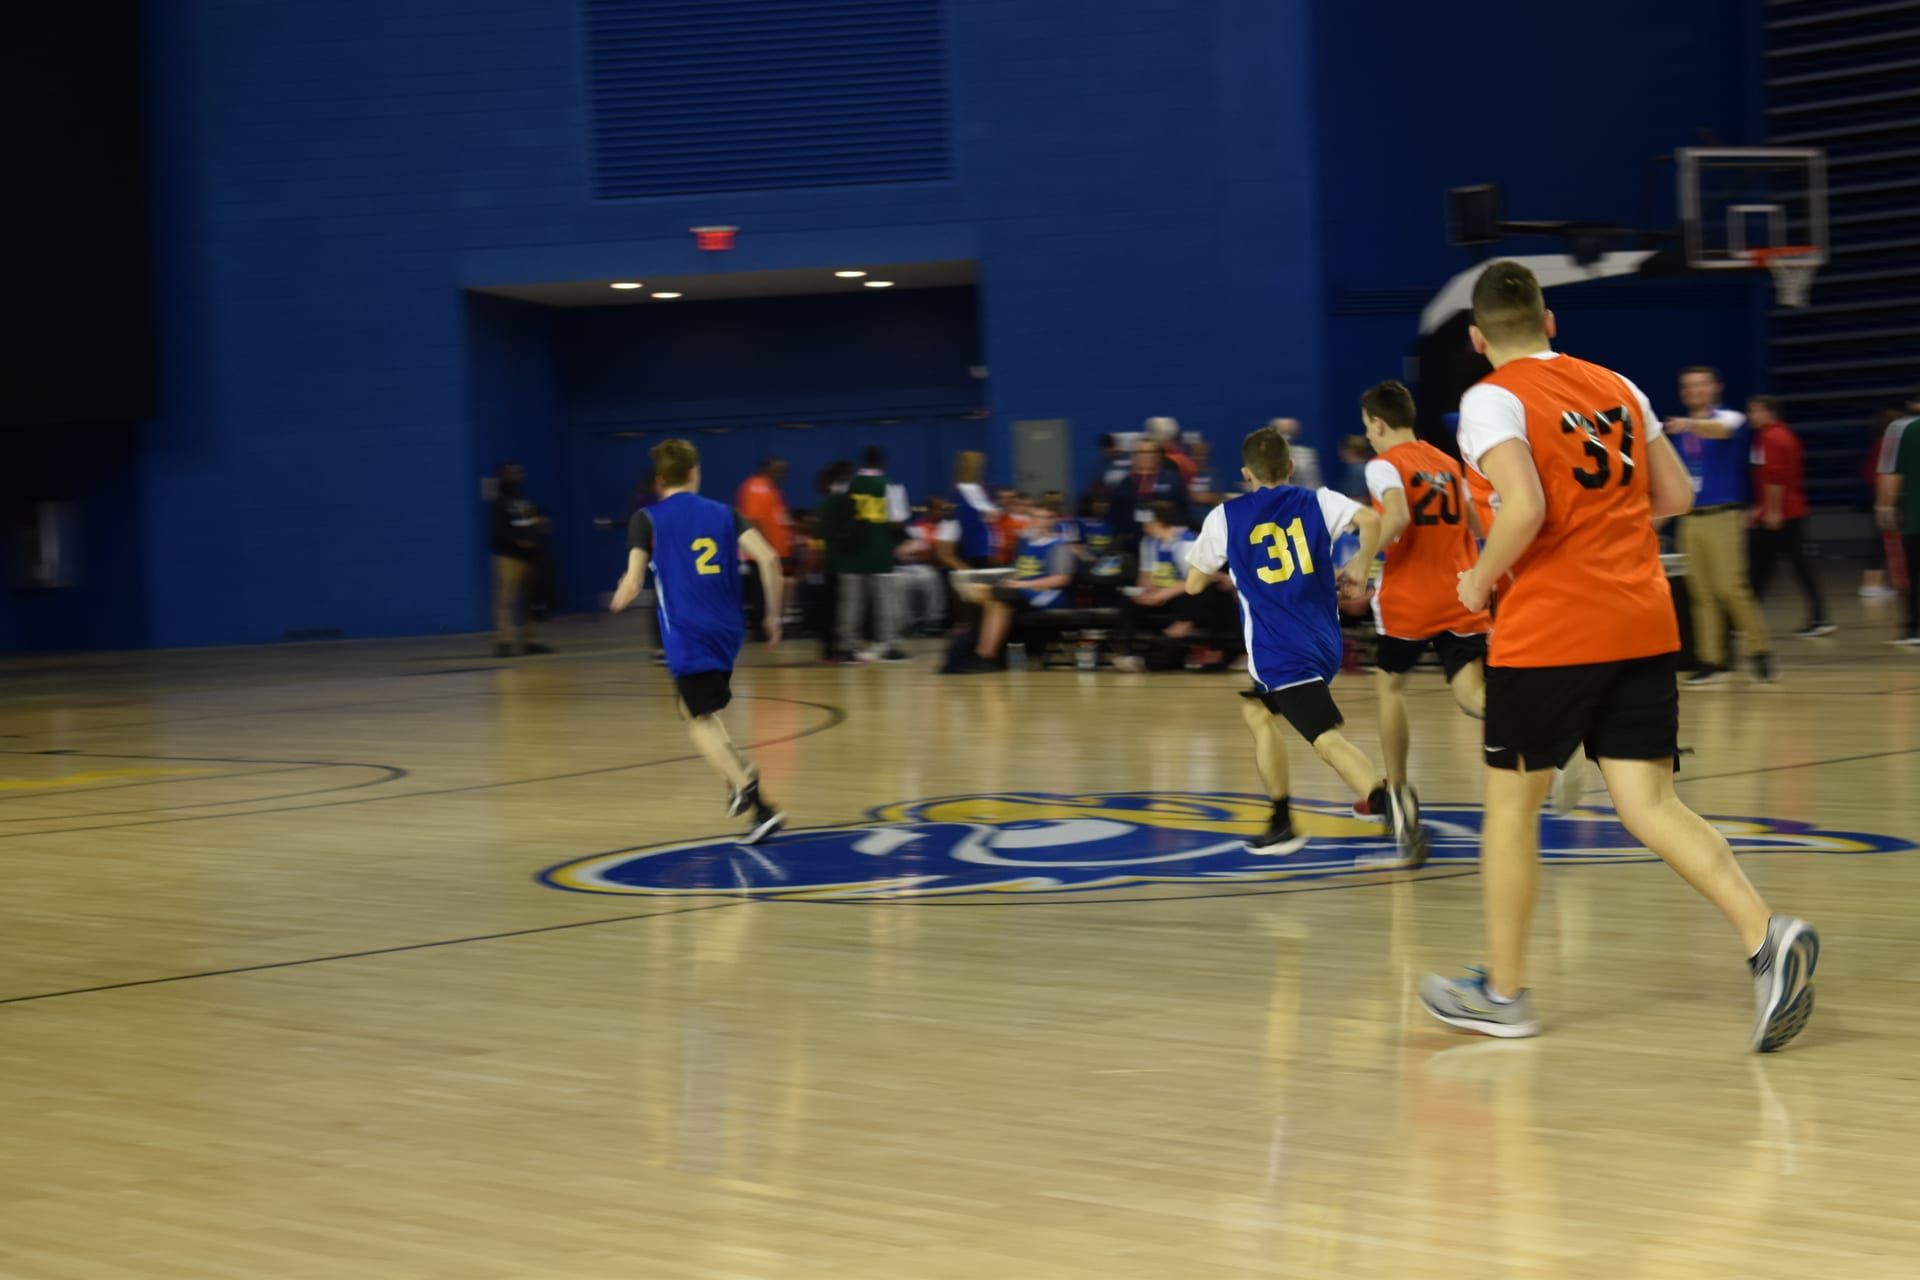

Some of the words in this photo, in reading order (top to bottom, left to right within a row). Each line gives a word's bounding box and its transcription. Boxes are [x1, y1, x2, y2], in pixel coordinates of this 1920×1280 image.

[1561, 405, 1635, 489] 37
[1411, 472, 1461, 525] 20
[691, 537, 720, 574] 2
[1249, 517, 1314, 584] 31
